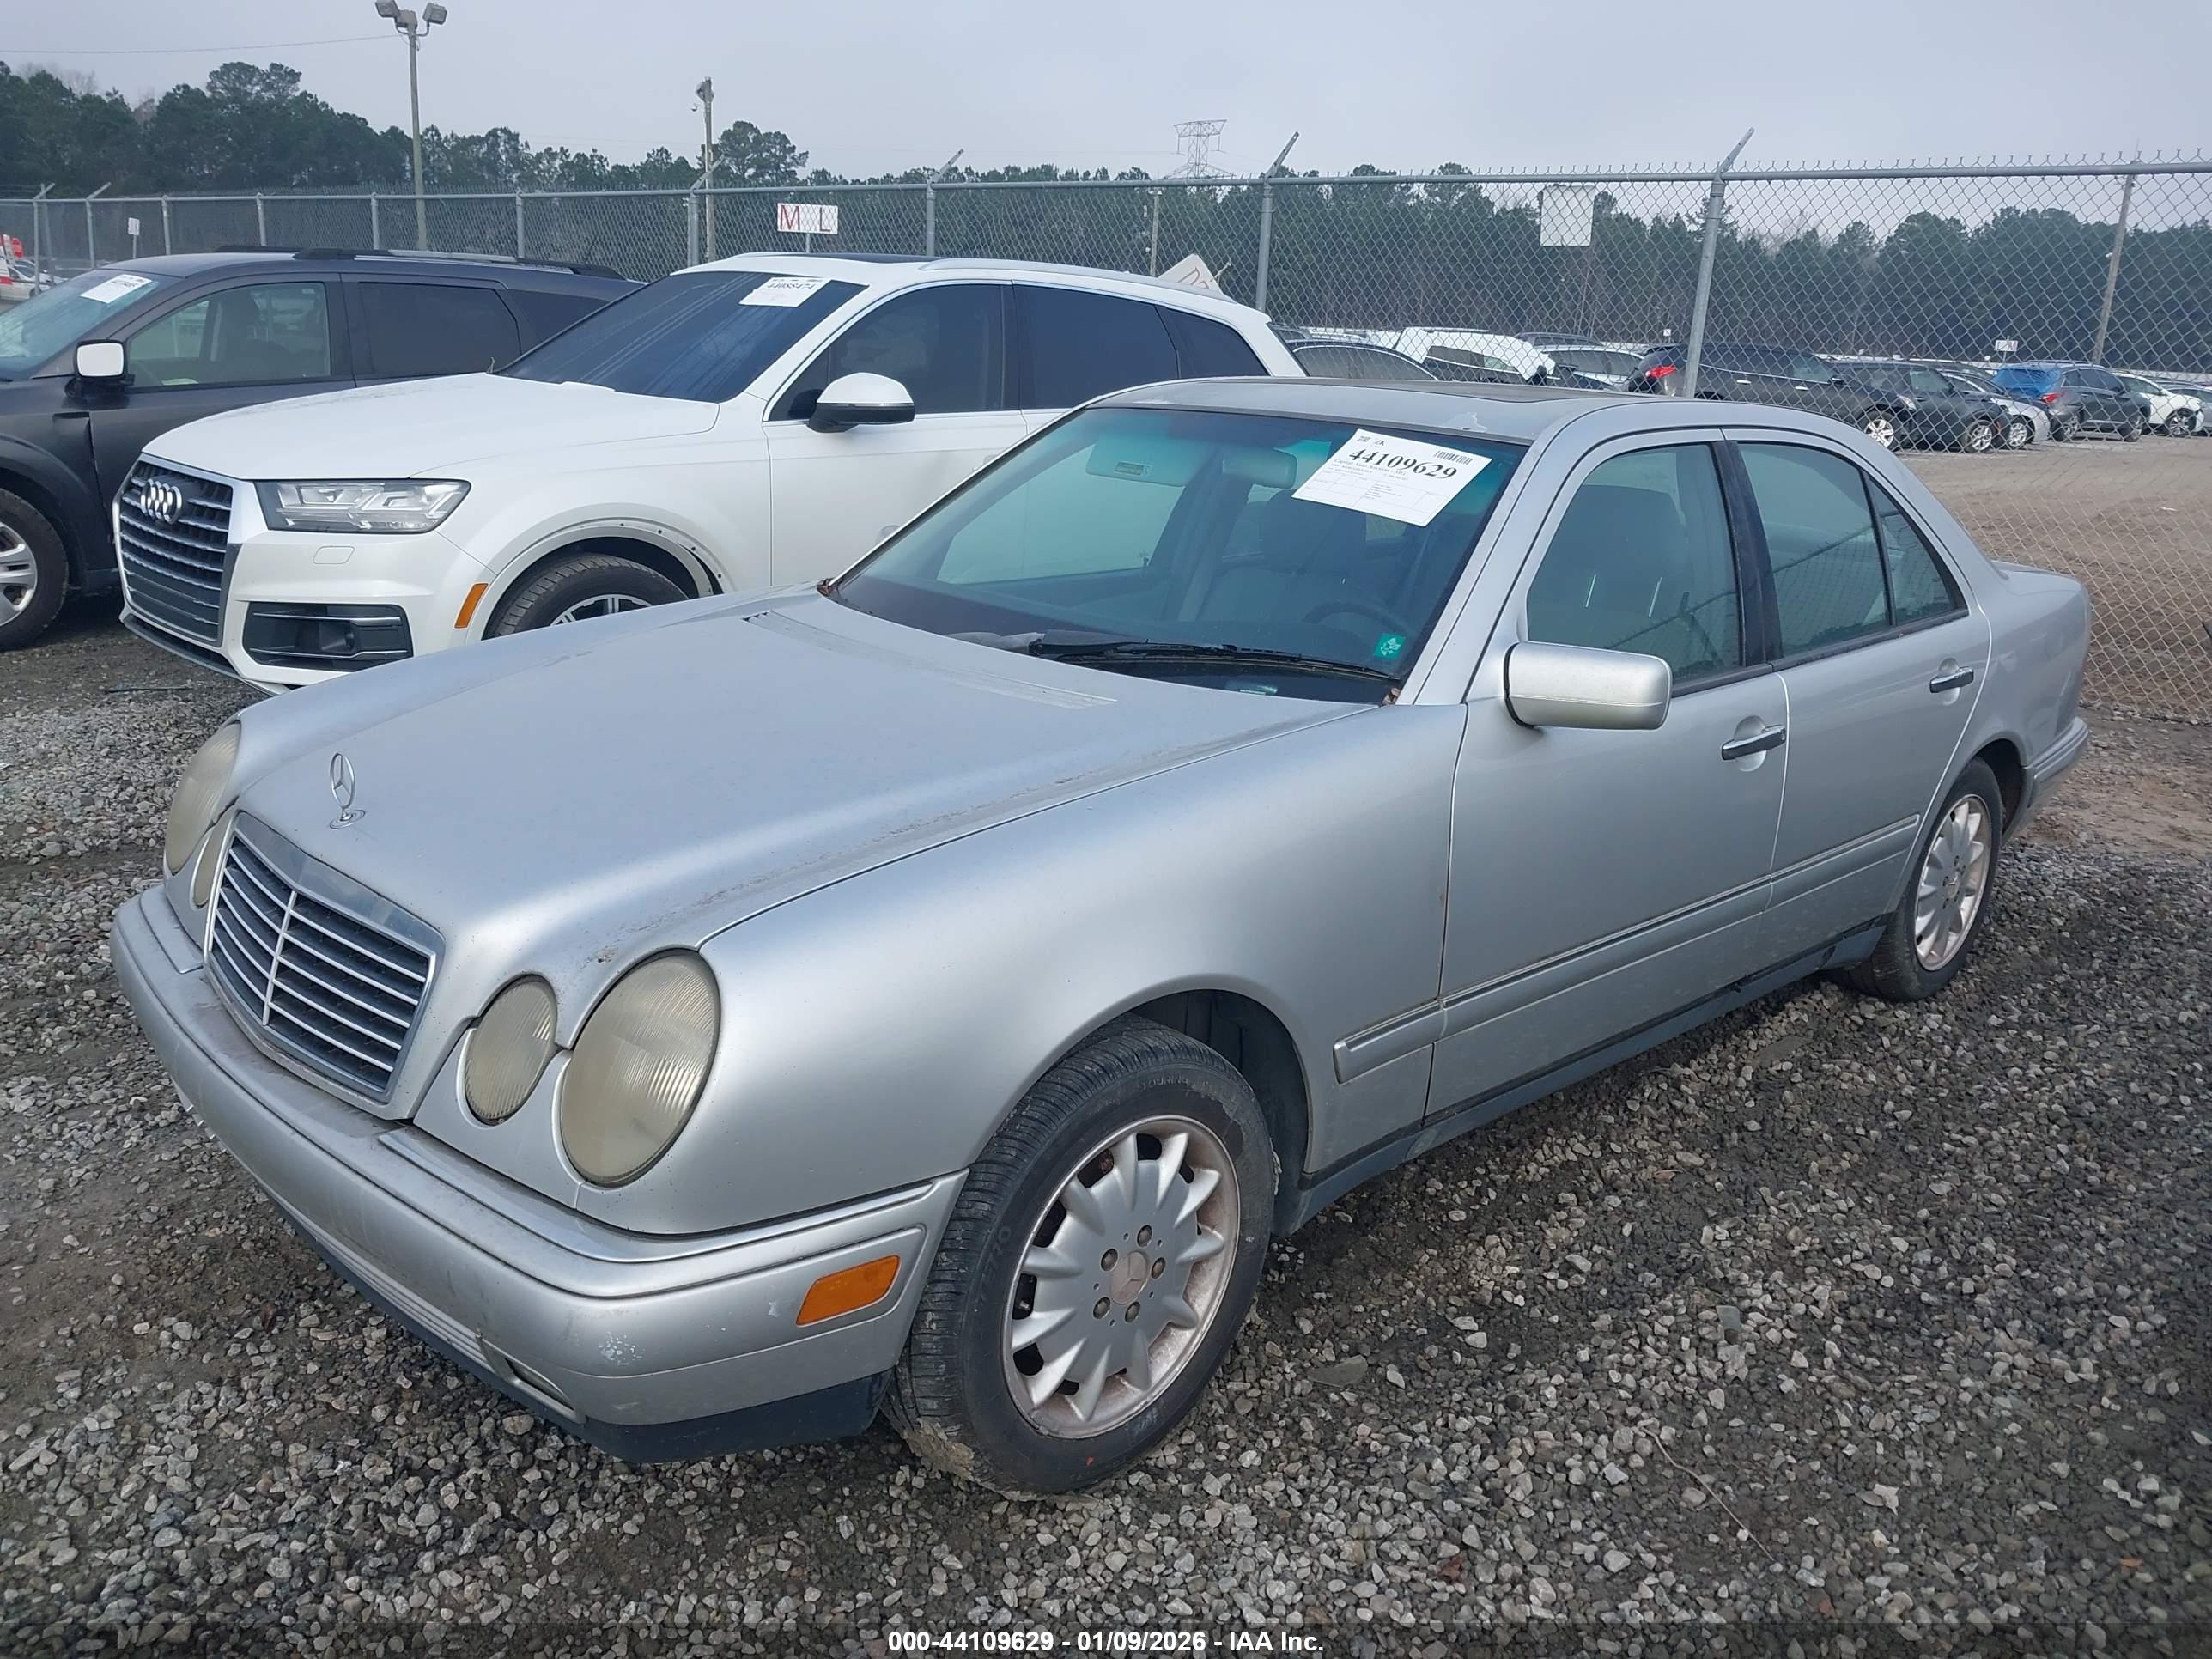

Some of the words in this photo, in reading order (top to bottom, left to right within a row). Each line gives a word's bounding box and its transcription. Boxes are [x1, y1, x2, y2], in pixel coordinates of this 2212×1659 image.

[780, 204, 800, 231] M
[819, 207, 831, 233] L
[1349, 448, 1457, 479] 44109629
